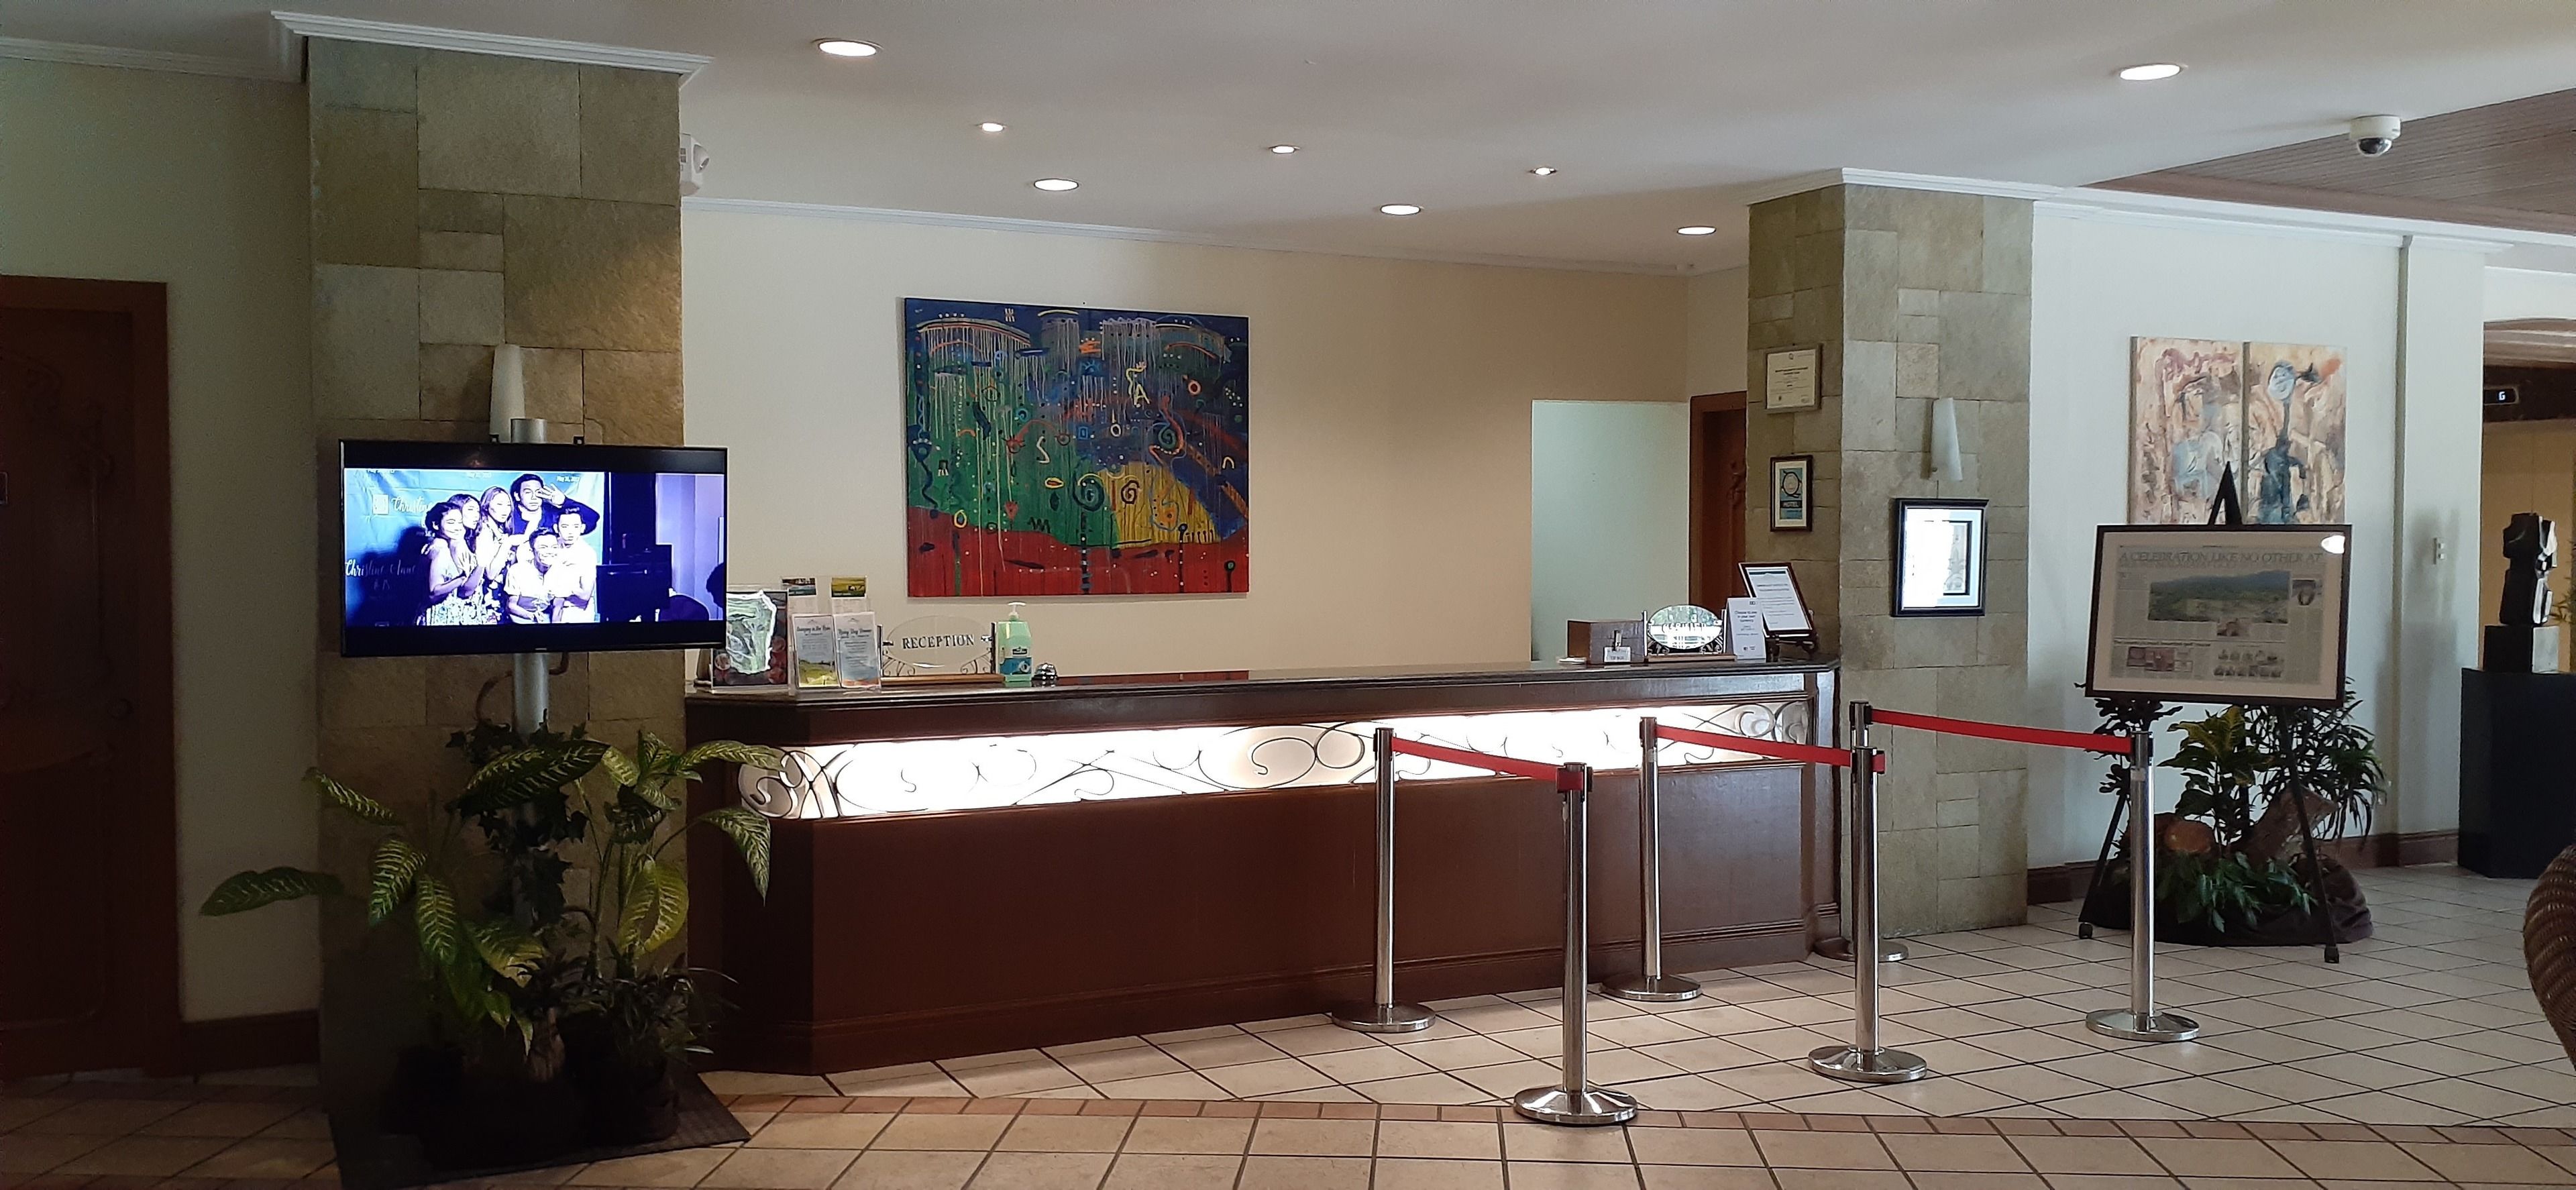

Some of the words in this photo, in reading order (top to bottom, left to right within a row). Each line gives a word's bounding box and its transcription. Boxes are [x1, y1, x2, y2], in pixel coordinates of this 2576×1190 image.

[2499, 391, 2506, 400] G
[2121, 552, 2127, 561] A
[2130, 551, 2206, 562] CELEBRATION
[2210, 552, 2238, 562] LIKE
[2239, 552, 2259, 562] NO
[2262, 552, 2303, 563] OTHER
[902, 634, 975, 649] RECEPTION
